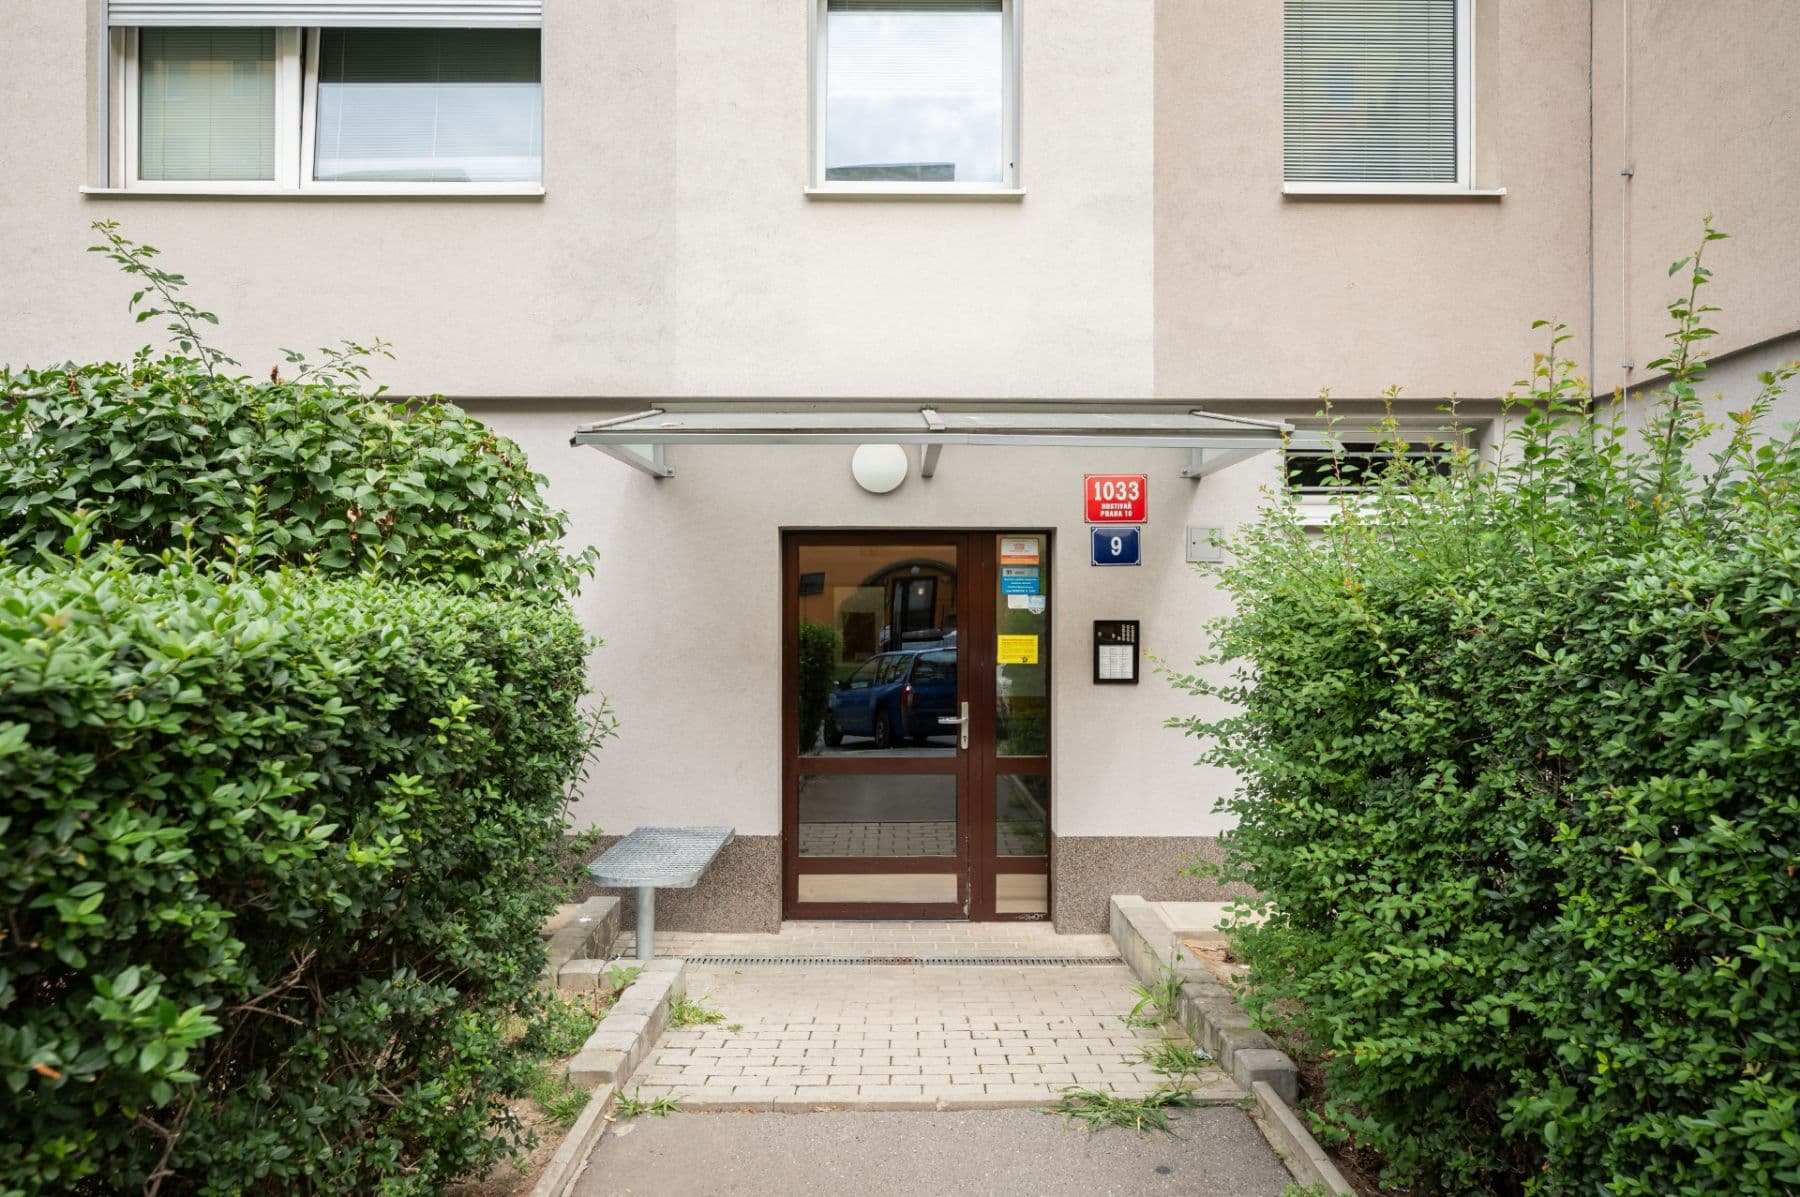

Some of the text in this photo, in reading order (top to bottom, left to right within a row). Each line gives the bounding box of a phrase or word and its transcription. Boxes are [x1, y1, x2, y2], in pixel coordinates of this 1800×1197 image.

[1094, 481, 1140, 501] 1033
[1102, 501, 1132, 509] HOSTIVAŘ
[1110, 536, 1122, 556] 9
